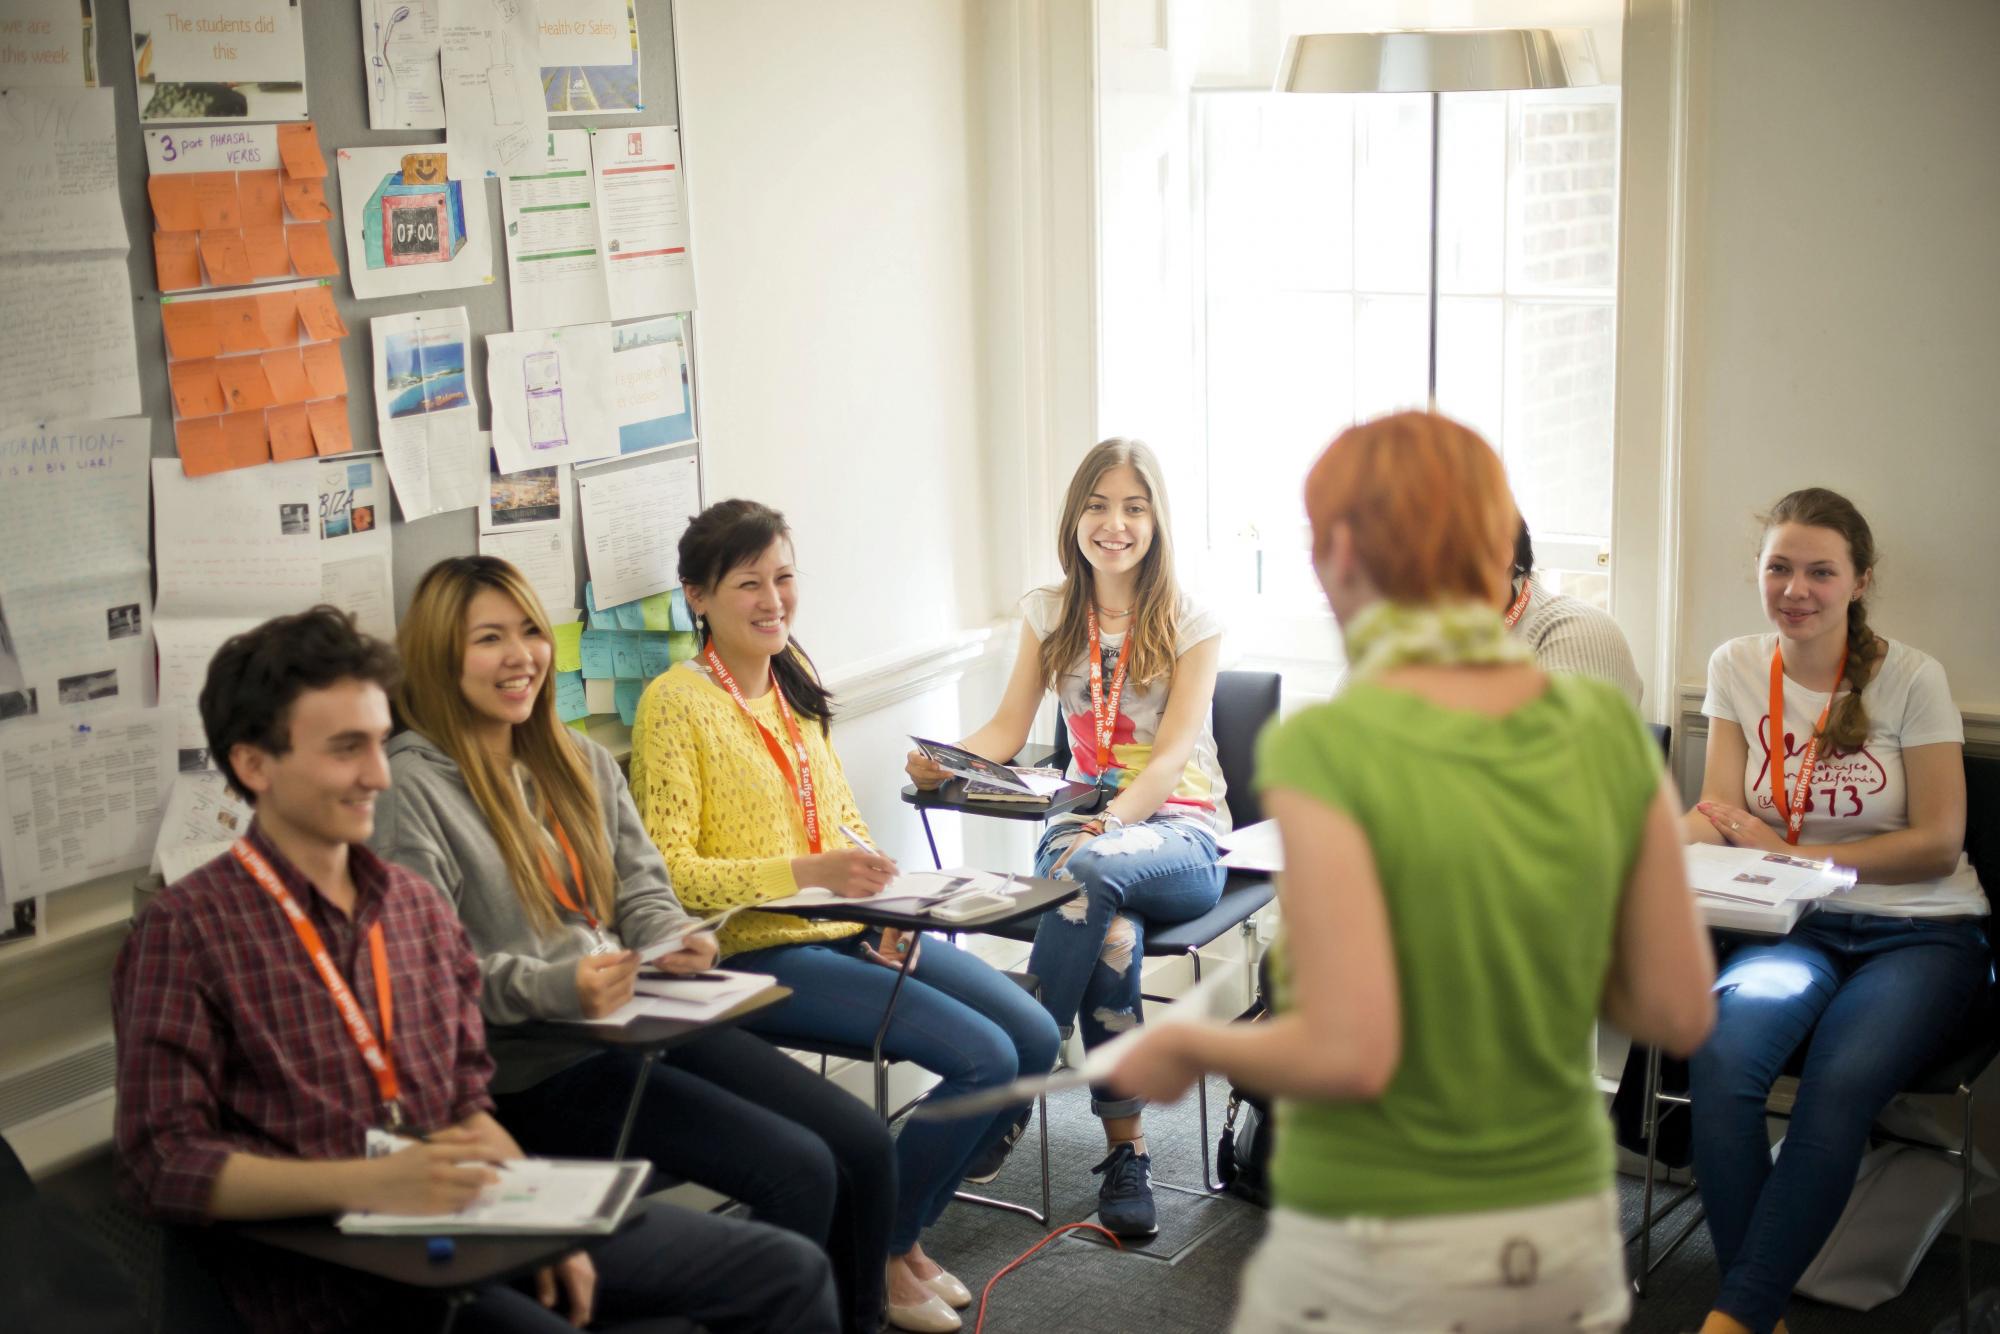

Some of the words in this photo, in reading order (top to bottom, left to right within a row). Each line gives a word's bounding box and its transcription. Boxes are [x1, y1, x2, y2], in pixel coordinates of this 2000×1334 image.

[166, 13, 193, 32] The
[196, 14, 250, 33] students
[255, 15, 275, 33] did
[538, 17, 573, 35] Health
[587, 18, 617, 40] Safety
[32, 45, 70, 64] week
[213, 42, 238, 60] this
[160, 134, 177, 161] 3
[181, 138, 204, 155] part
[210, 131, 254, 149] PHRASAL
[226, 148, 261, 164] VERBS
[397, 223, 434, 243] 07:00
[1092, 683, 1104, 719] Stafford
[1105, 691, 1120, 727] Stafford
[1096, 720, 1105, 747] Hou
[802, 766, 815, 808] Stafford
[1793, 768, 1812, 809] Stafford
